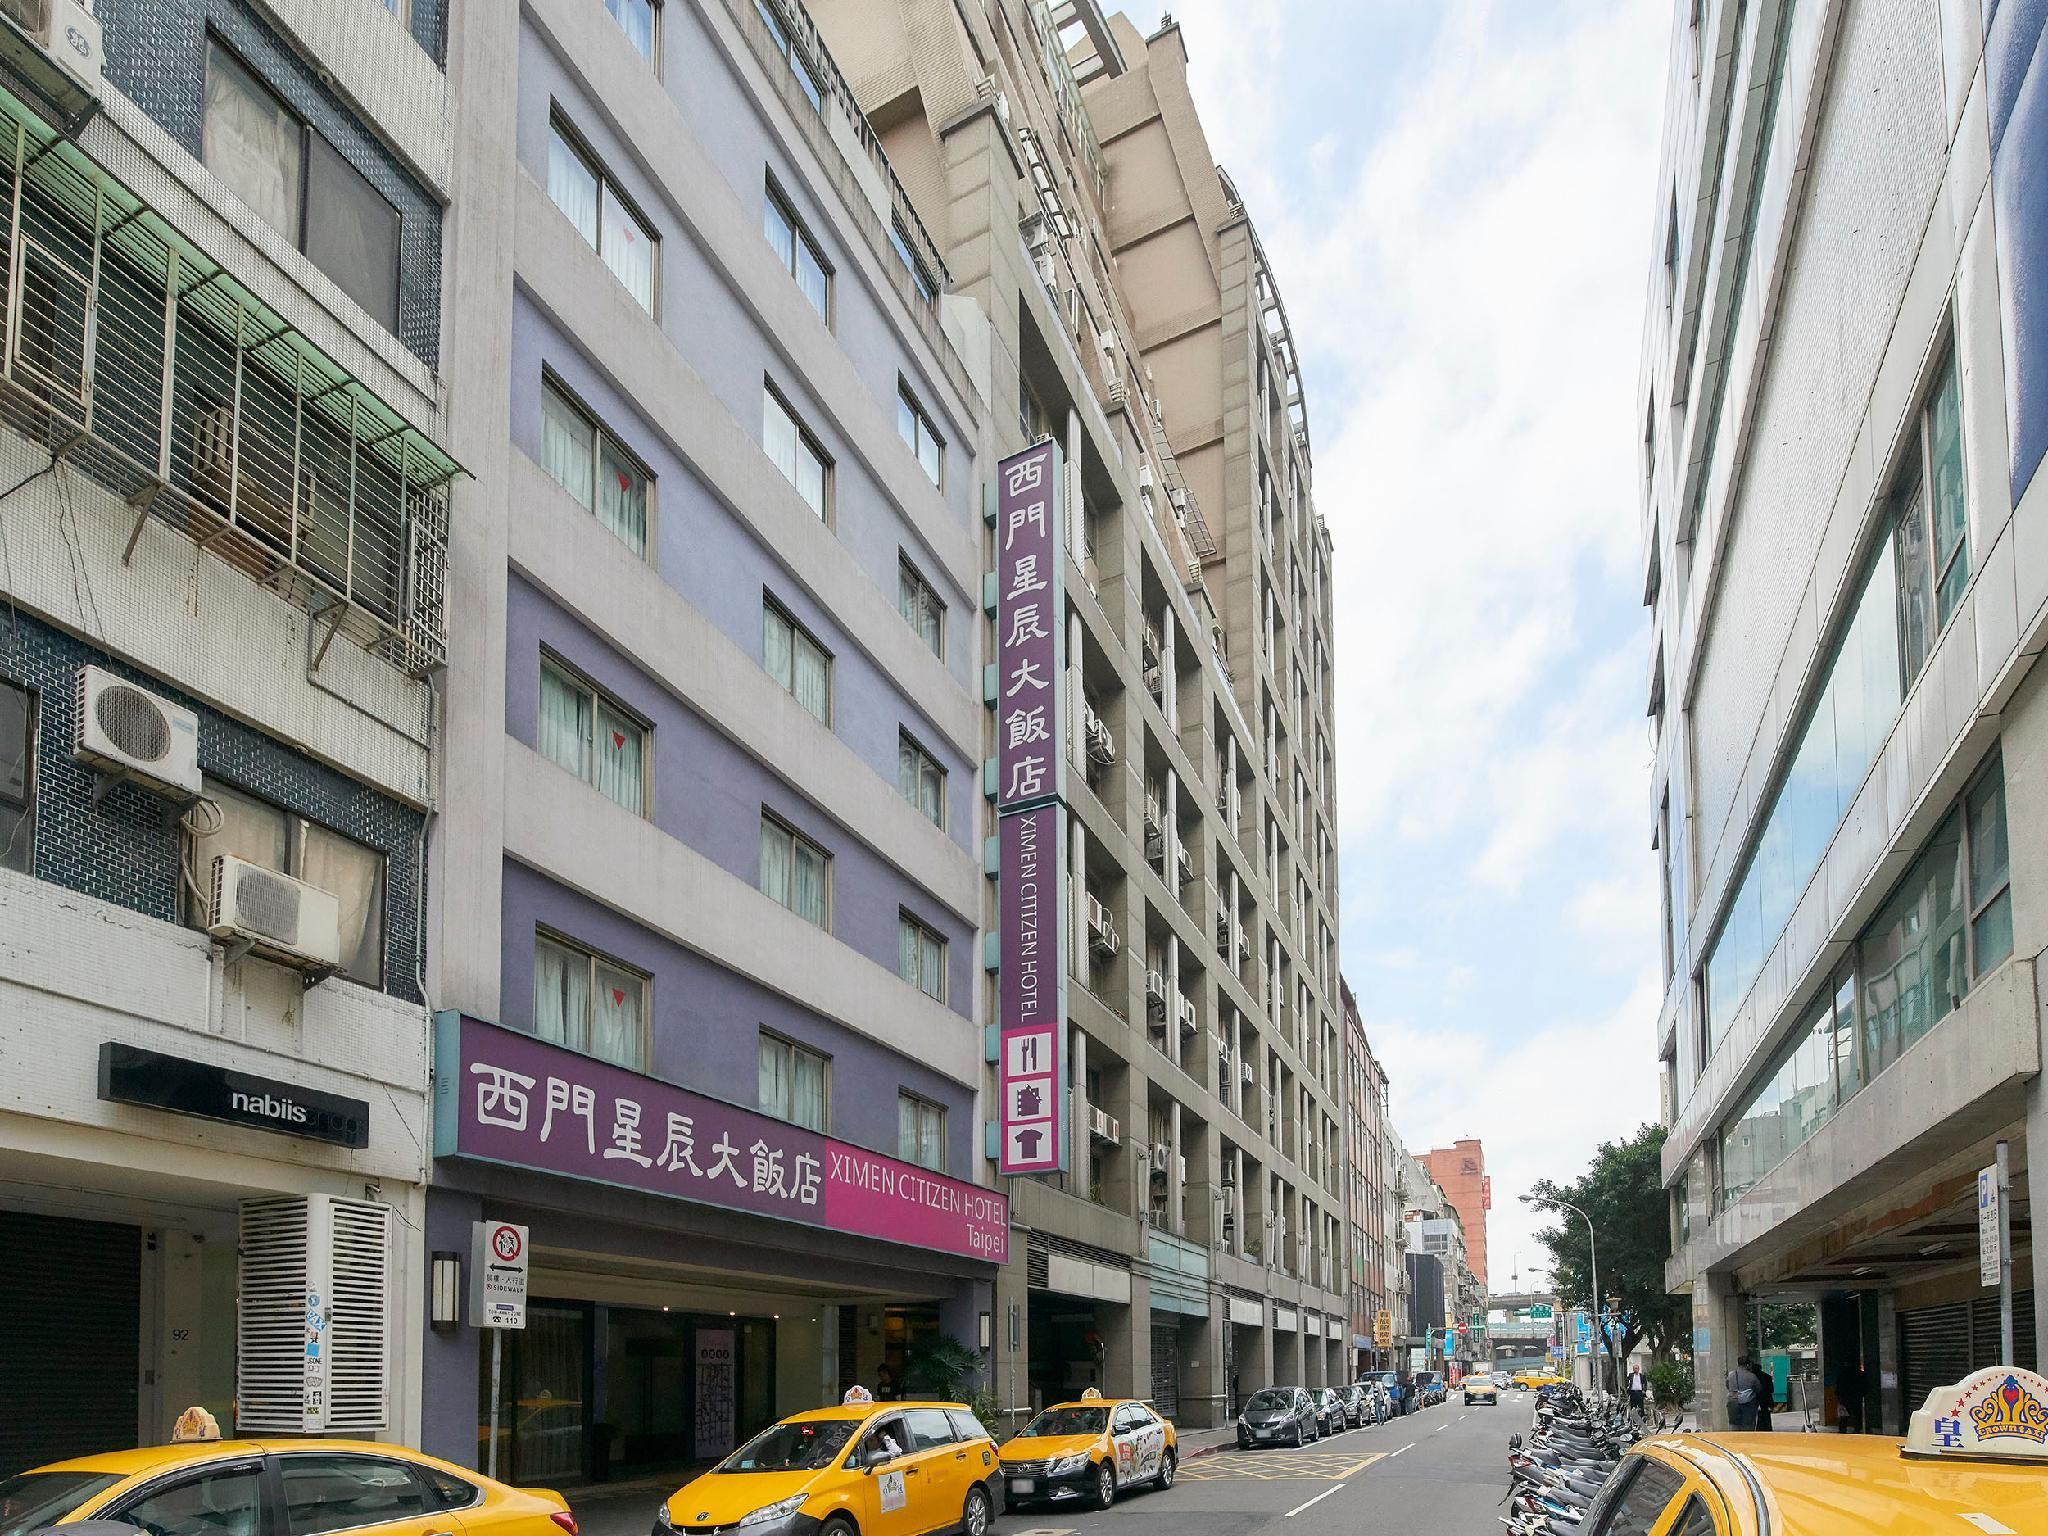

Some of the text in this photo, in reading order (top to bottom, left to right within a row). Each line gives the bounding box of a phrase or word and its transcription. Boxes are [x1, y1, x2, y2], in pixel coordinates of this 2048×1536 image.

[1004, 452, 1051, 799] 西門星辰大飯店
[1020, 814, 1038, 1023] XIMEN CITIZEN HOTEL
[232, 1092, 307, 1124] nabiis
[470, 1062, 822, 1206] 西門星辰大飯店
[830, 1151, 1007, 1227] XIMEN CITIZEN HOTEL
[966, 1223, 1005, 1256] Taipei
[172, 1328, 189, 1341] 92
[1931, 1417, 1965, 1449] 皇
